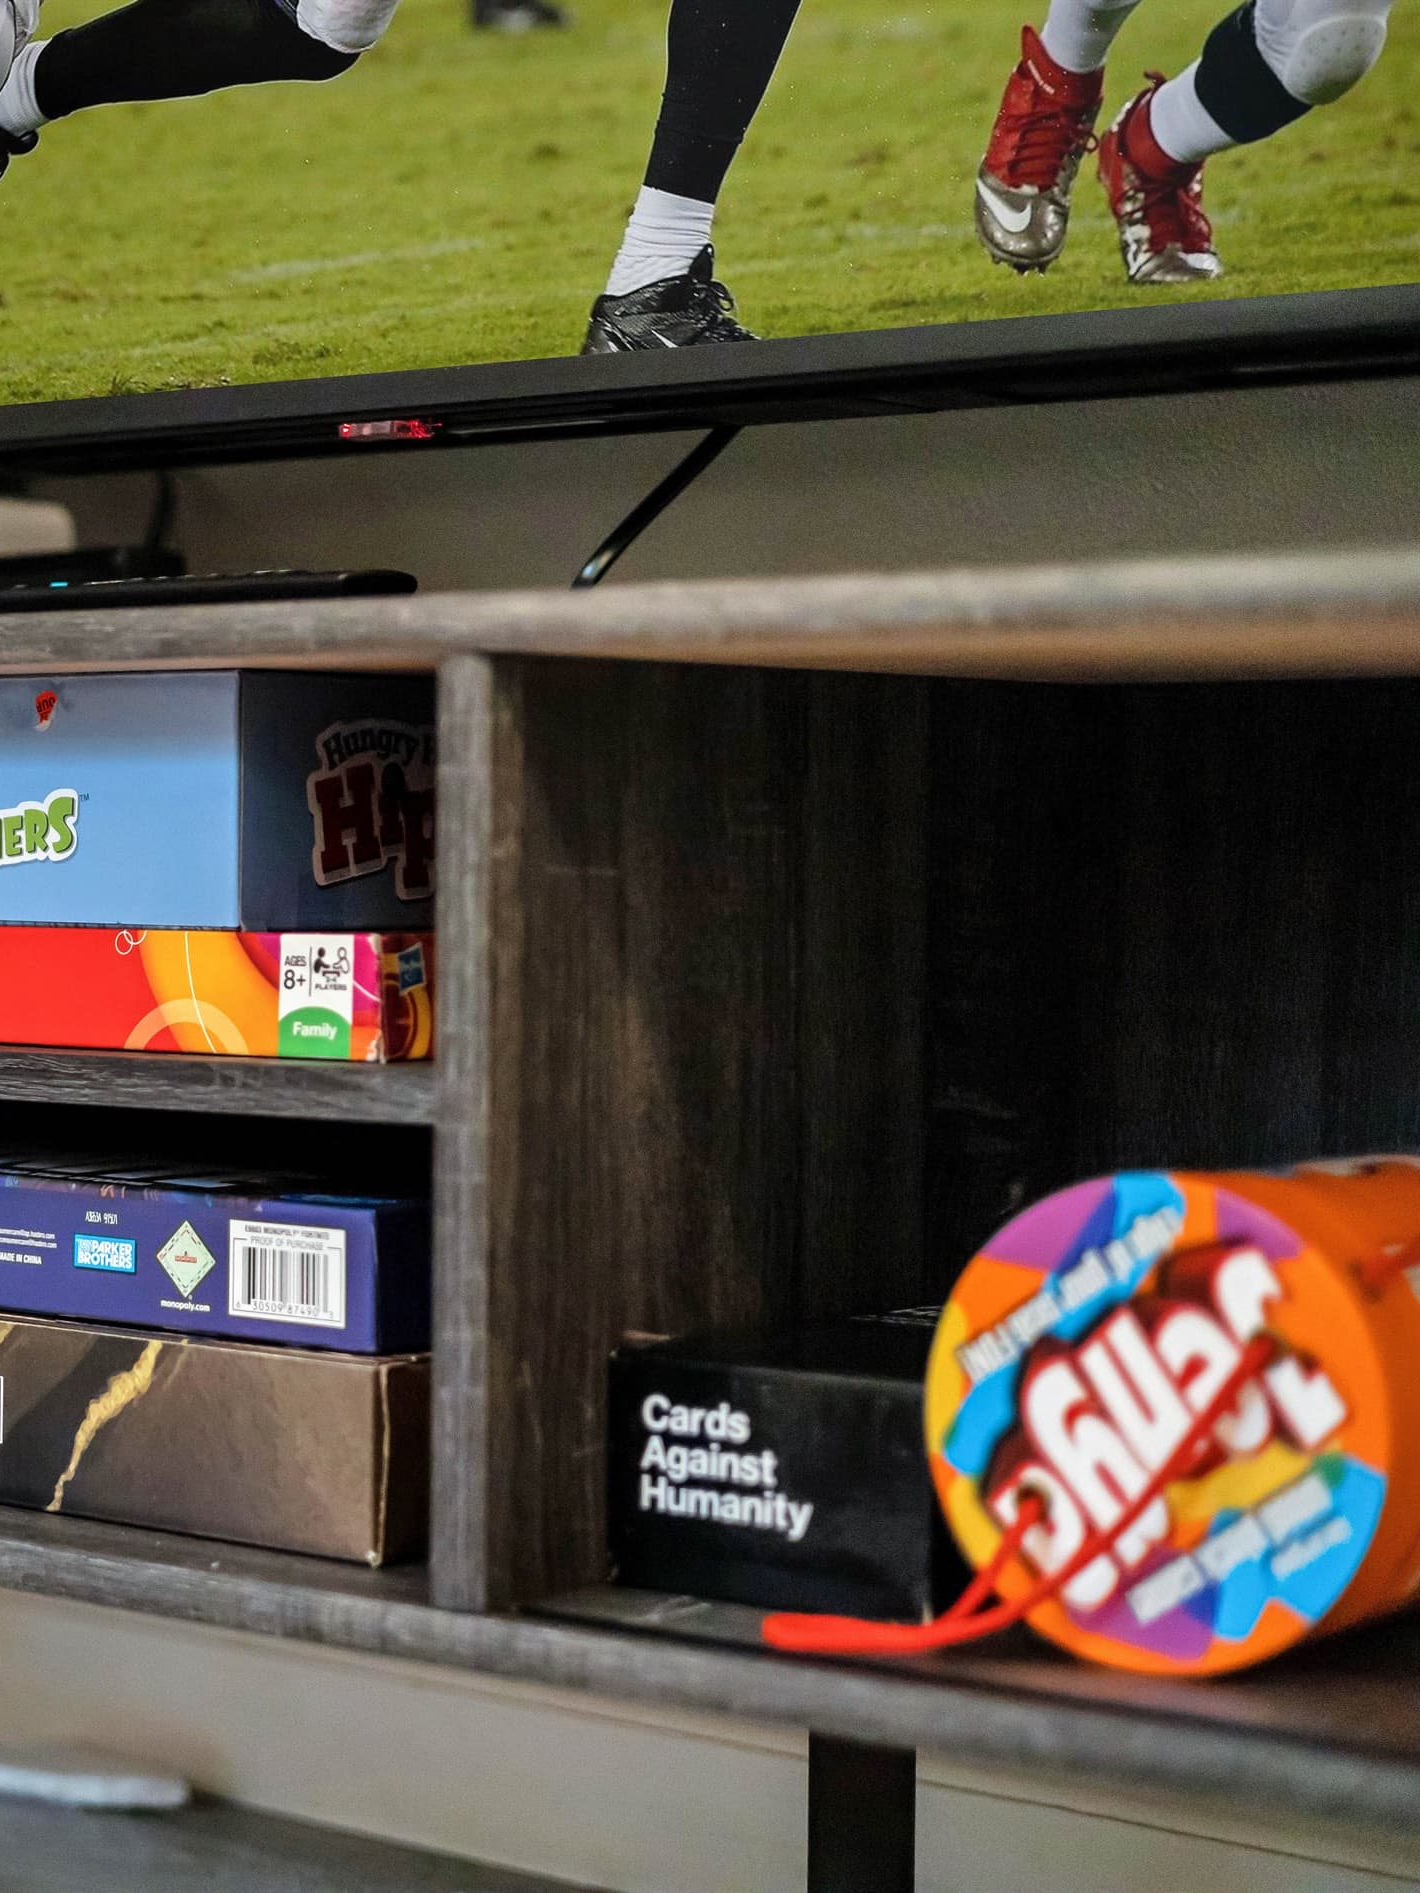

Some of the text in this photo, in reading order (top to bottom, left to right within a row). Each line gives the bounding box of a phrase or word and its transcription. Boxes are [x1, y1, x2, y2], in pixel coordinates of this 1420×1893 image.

[322, 727, 420, 770] Hungry
[315, 762, 436, 889] Hip
[284, 955, 307, 967] AGES
[283, 969, 306, 990] 8+
[315, 983, 347, 991] PLAYERS
[292, 1021, 338, 1041] Family
[91, 1240, 132, 1256] PARKER
[250, 1236, 324, 1251] PROOF OF PURCHASE
[16, 1253, 23, 1263] IN
[23, 1254, 42, 1265] CHINA
[77, 1252, 132, 1269] BROTHERS
[160, 1300, 211, 1312] monopoly.com
[252, 1302, 283, 1312] 30509
[287, 1304, 318, 1317] 87490
[641, 1393, 751, 1444] Cards
[640, 1434, 778, 1489] Against
[639, 1472, 814, 1543] Humanity
